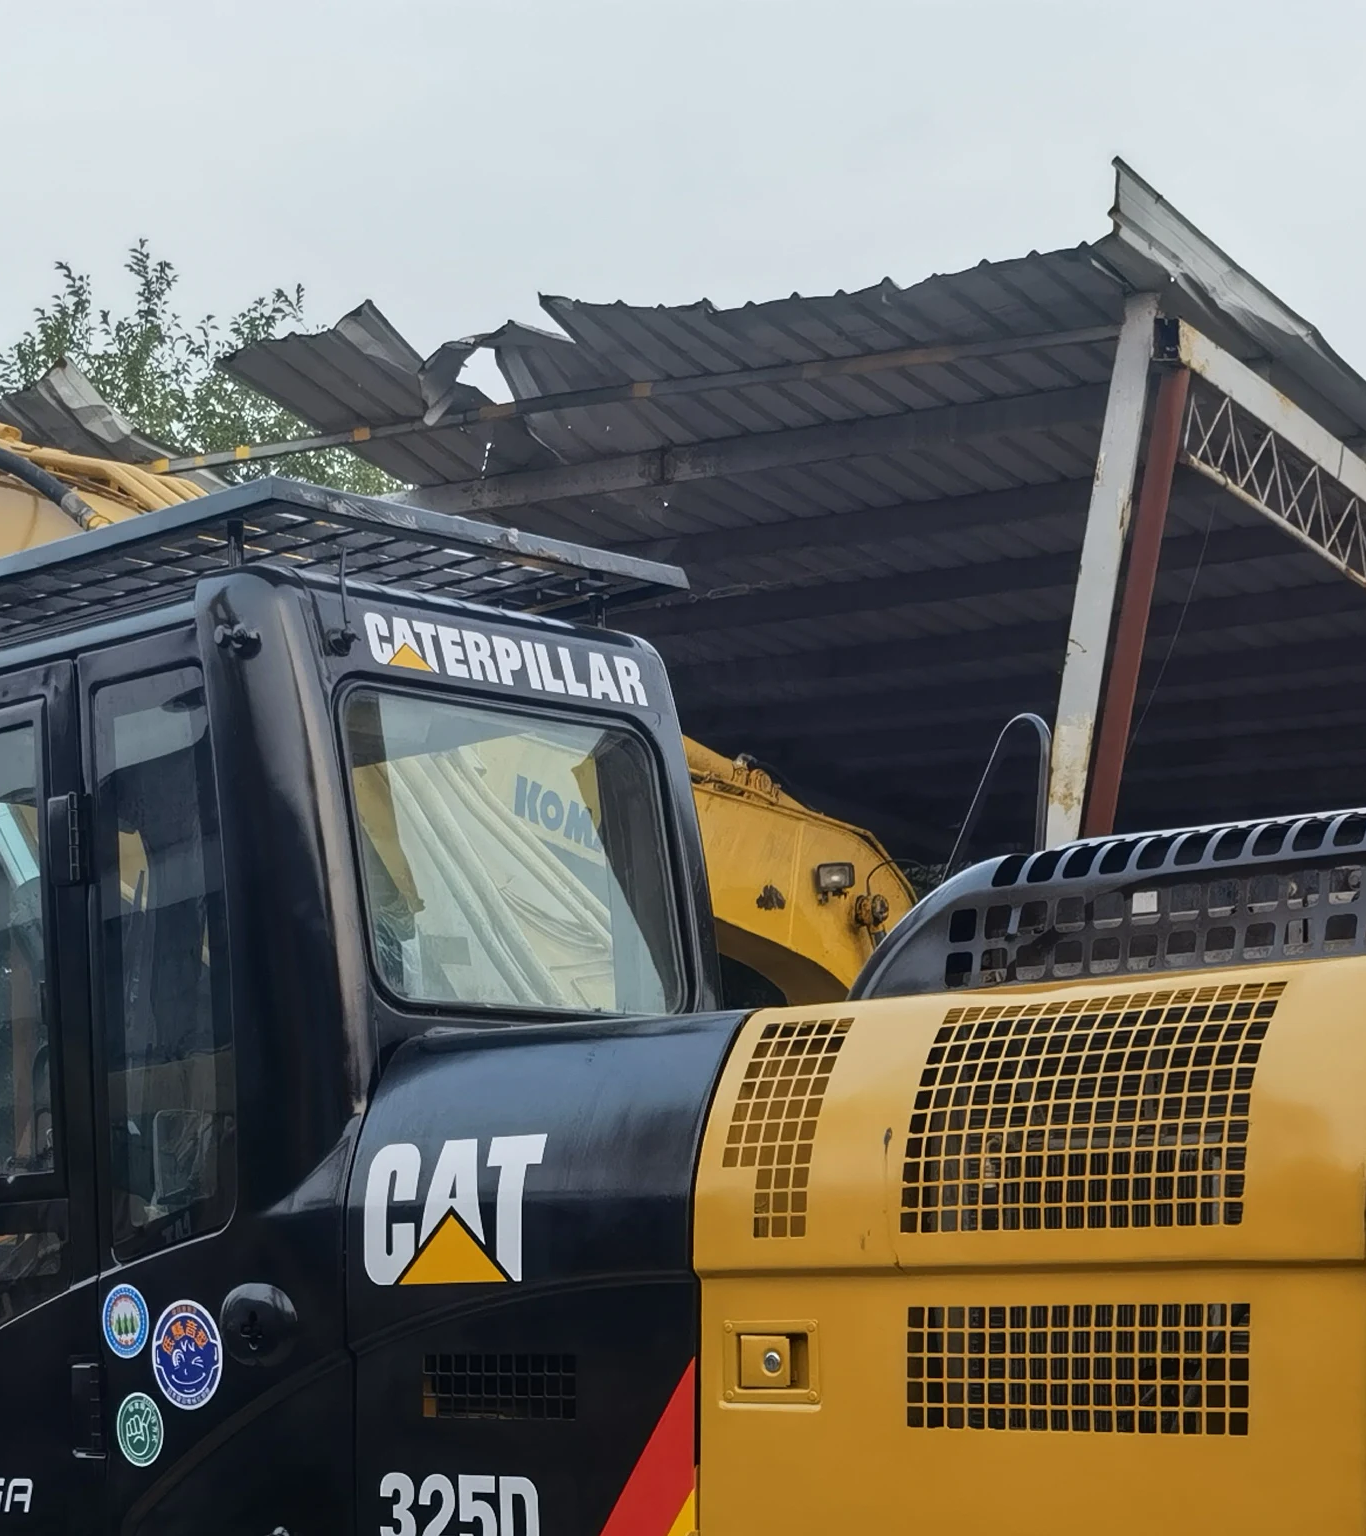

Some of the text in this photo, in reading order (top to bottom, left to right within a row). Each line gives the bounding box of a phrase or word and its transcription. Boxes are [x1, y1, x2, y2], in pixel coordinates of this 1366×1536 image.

[364, 611, 648, 707] CATERPILLAR
[514, 773, 603, 854] KOM
[363, 1133, 549, 1286] CAT
